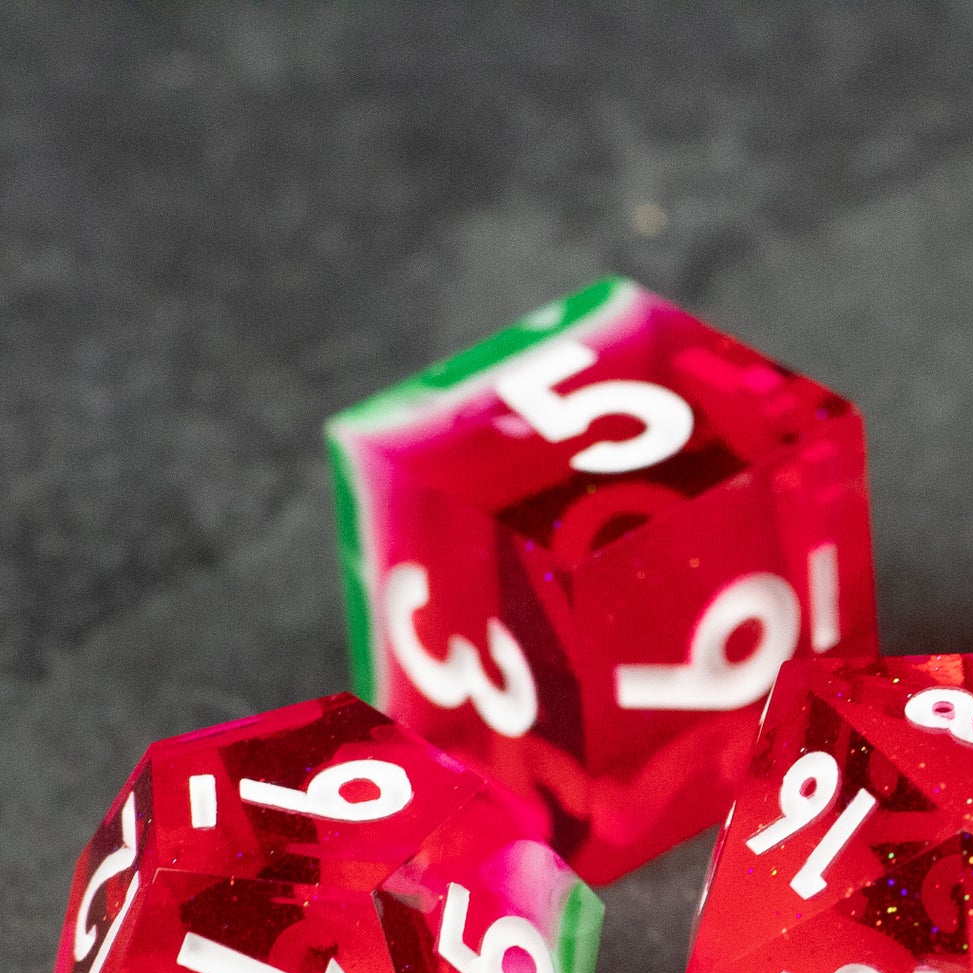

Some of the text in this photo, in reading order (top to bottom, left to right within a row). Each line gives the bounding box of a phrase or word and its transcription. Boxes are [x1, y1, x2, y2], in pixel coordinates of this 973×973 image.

[495, 341, 694, 473] 5
[384, 561, 539, 738] 3
[746, 750, 877, 901] 16
